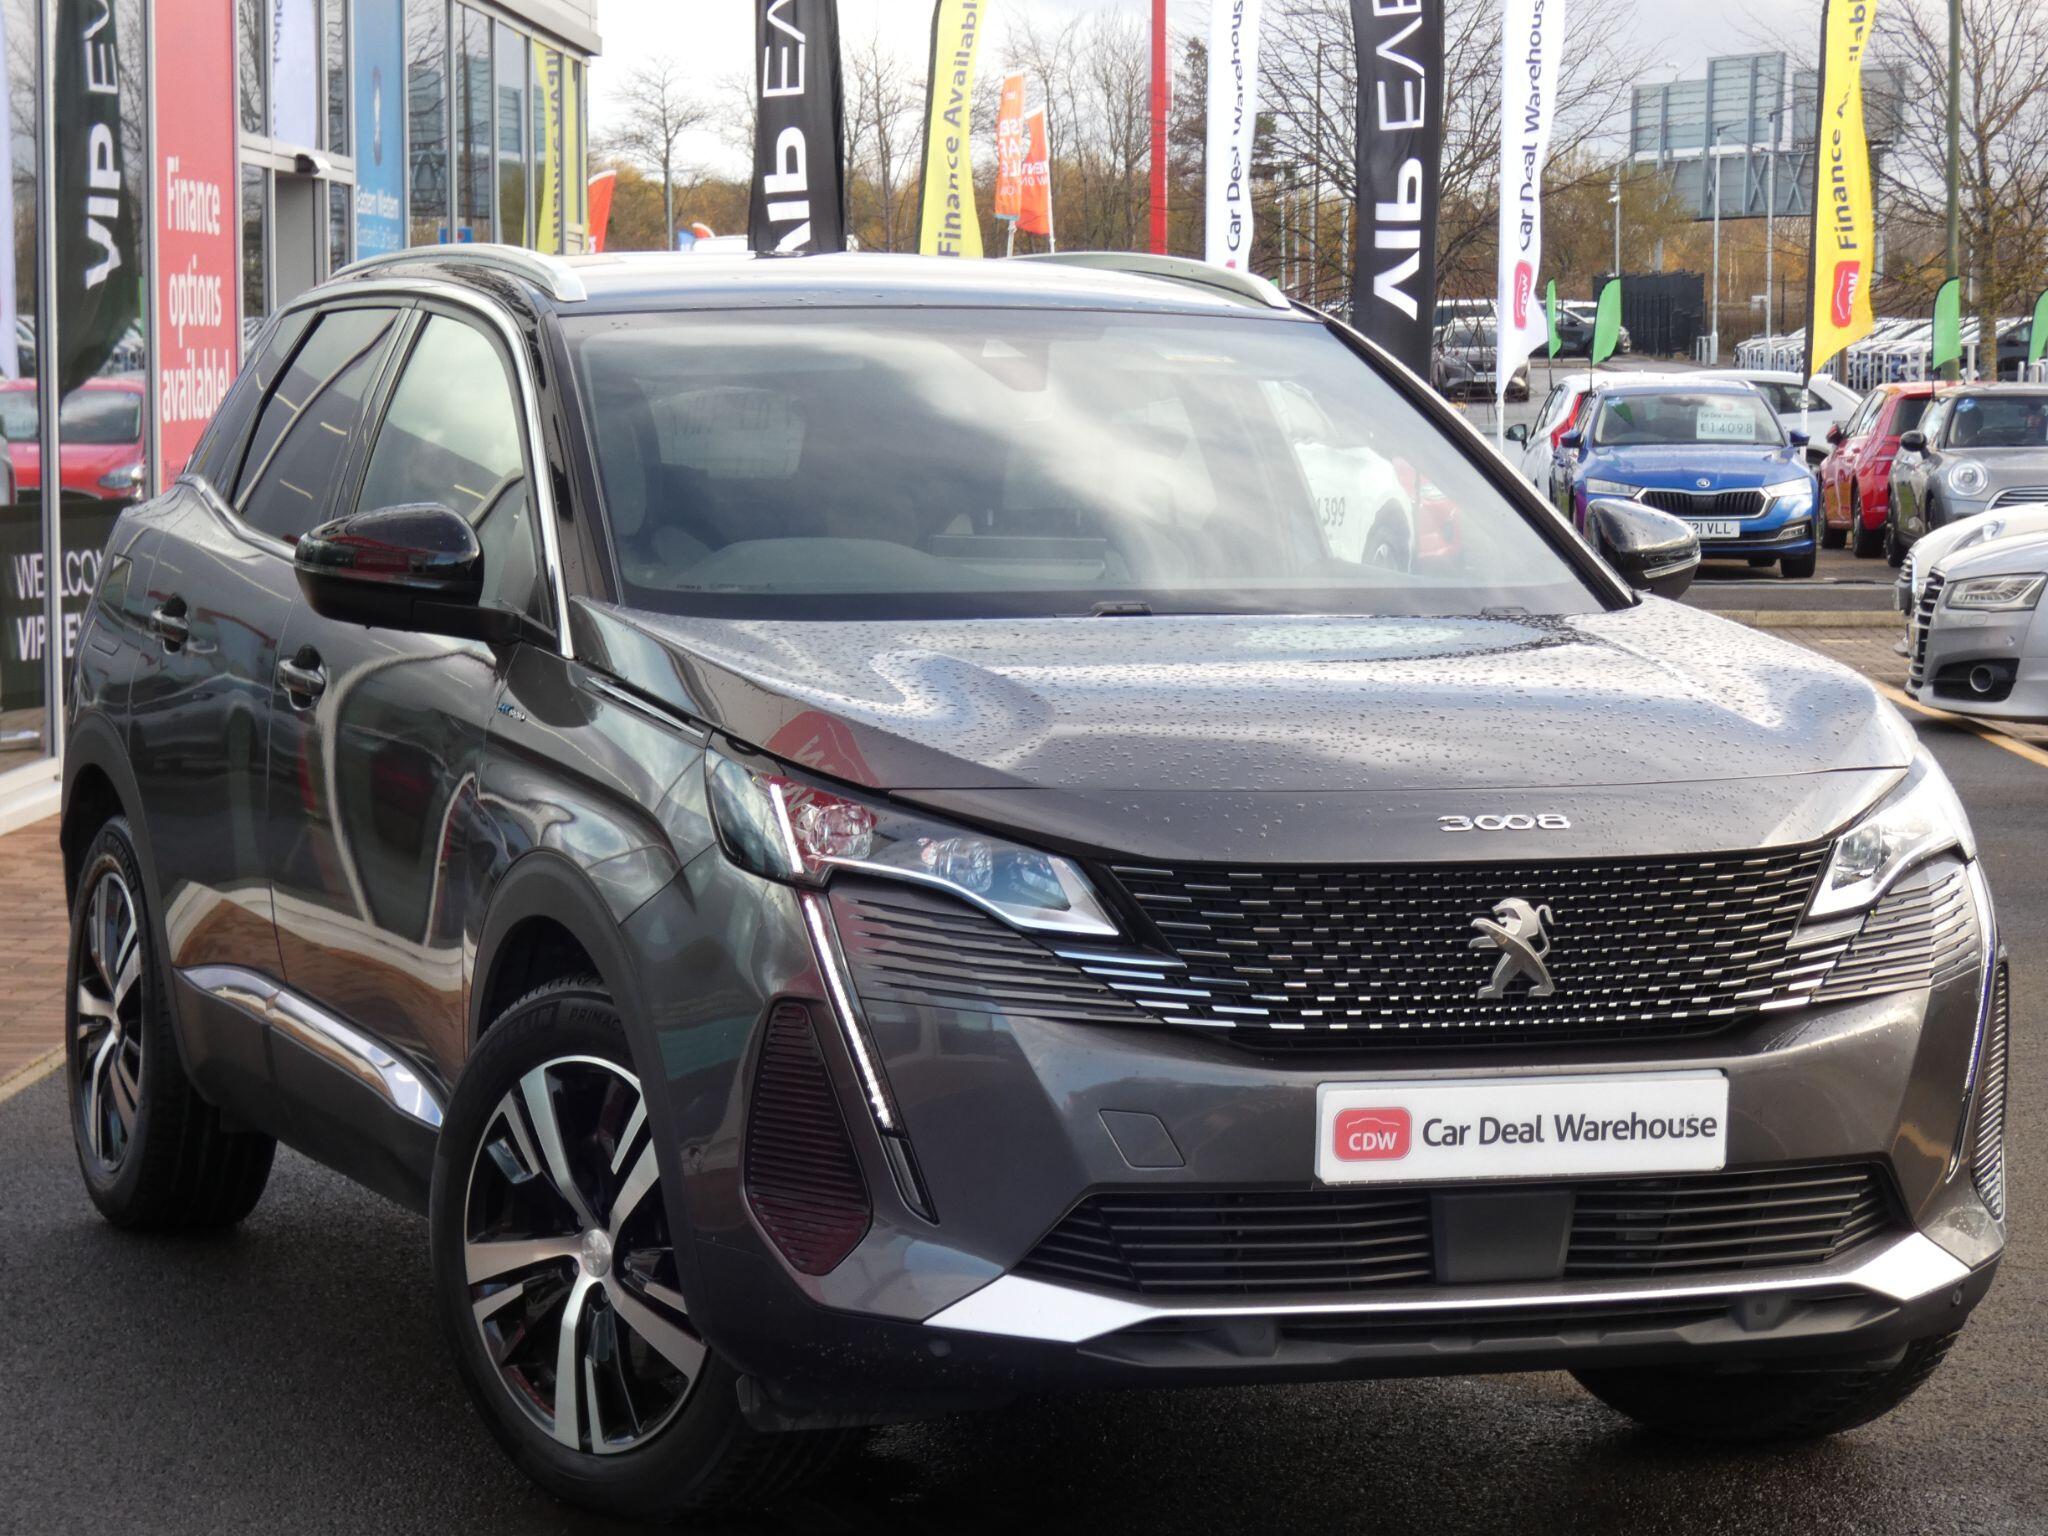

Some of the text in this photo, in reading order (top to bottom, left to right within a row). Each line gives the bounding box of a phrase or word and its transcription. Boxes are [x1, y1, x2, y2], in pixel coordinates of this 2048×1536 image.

[937, 0, 978, 257] Finance Availabl
[166, 155, 221, 236] Finance
[1519, 142, 1538, 202] Deal
[1831, 128, 1857, 250] Finance
[85, 123, 121, 290] VIP
[1227, 208, 1241, 251] Car
[1519, 209, 1534, 252] Car
[168, 252, 222, 349] options
[1707, 522, 1732, 535] VLL
[17, 614, 46, 662] VIP
[1437, 813, 1572, 833] 3008
[1349, 1111, 1718, 1151] CDW Car Deal Warehouse
